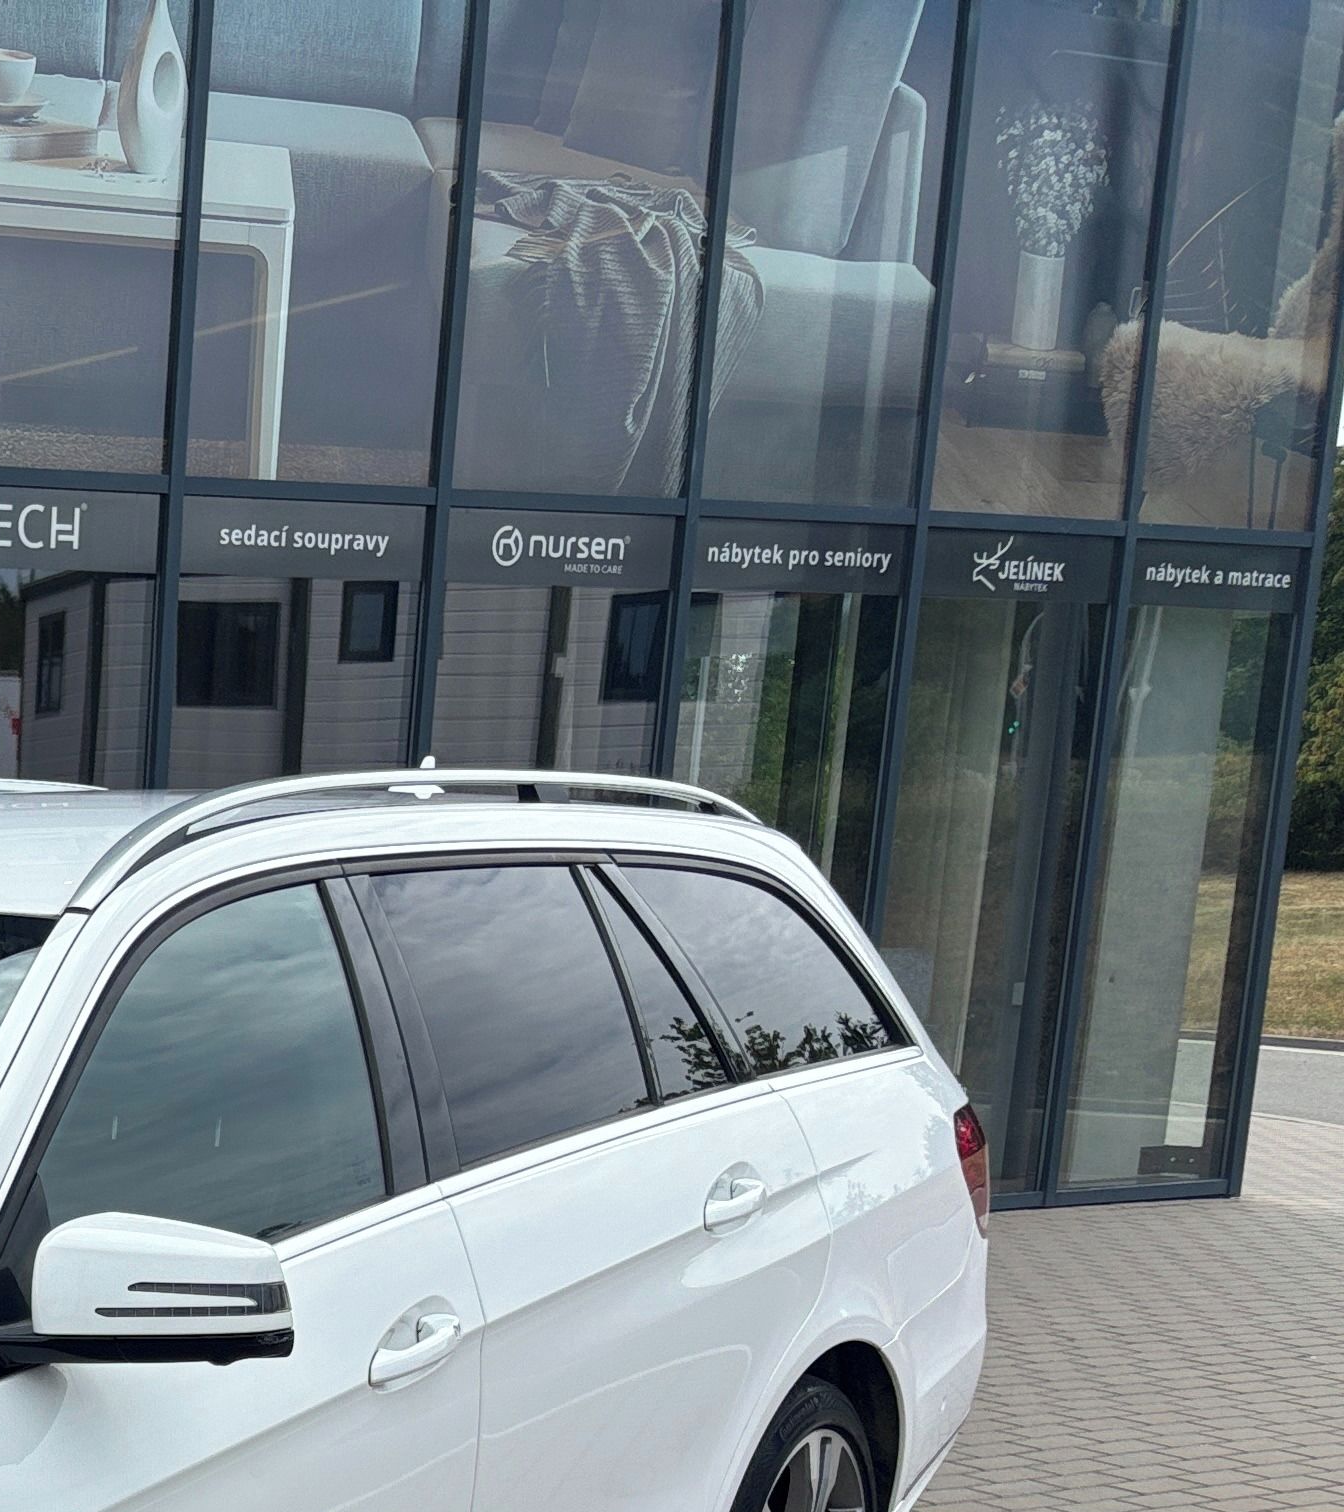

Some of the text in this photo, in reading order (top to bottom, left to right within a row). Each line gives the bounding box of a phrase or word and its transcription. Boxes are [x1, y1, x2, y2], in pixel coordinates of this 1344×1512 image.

[219, 524, 390, 557] sedací soupravy
[564, 563, 623, 575] MADE TO CARE
[707, 542, 893, 574] nábytek pro seniory
[997, 555, 1066, 582] JELÍNEK
[1145, 561, 1292, 589] nábytek a matrace
